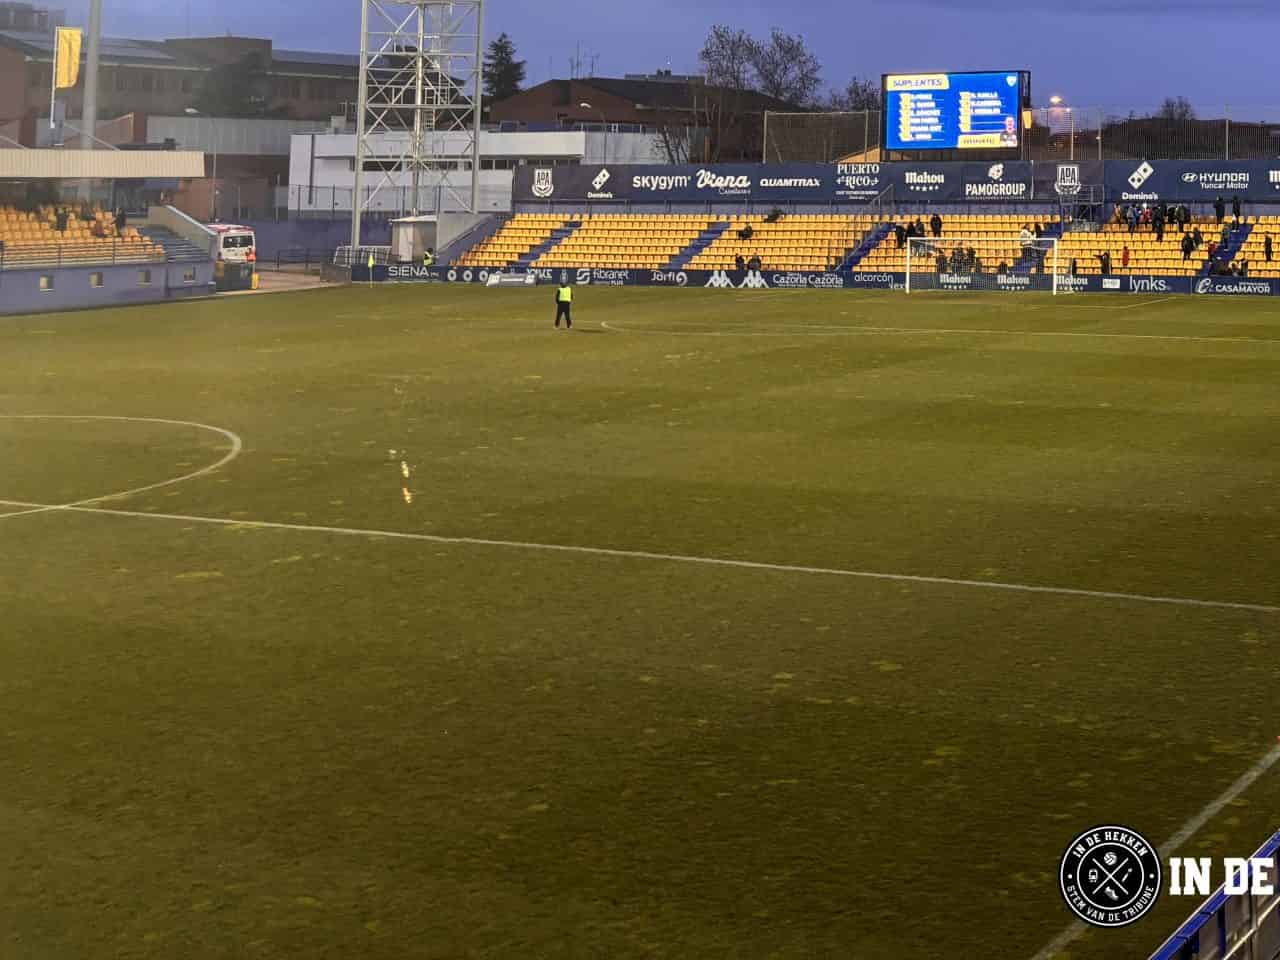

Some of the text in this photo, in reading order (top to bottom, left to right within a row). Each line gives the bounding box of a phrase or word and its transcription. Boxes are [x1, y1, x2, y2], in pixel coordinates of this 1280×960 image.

[837, 163, 880, 175] PUERTO
[760, 178, 820, 187] QUAMTRAX
[845, 175, 871, 189] RICO
[905, 171, 945, 184] Mahou
[1200, 172, 1250, 182] HYUNDAI
[965, 183, 1026, 196] PAMOGROUP
[1122, 192, 1158, 200] Domino's
[388, 266, 429, 277] SIENA
[1215, 284, 1271, 294] CASAMAYOR
